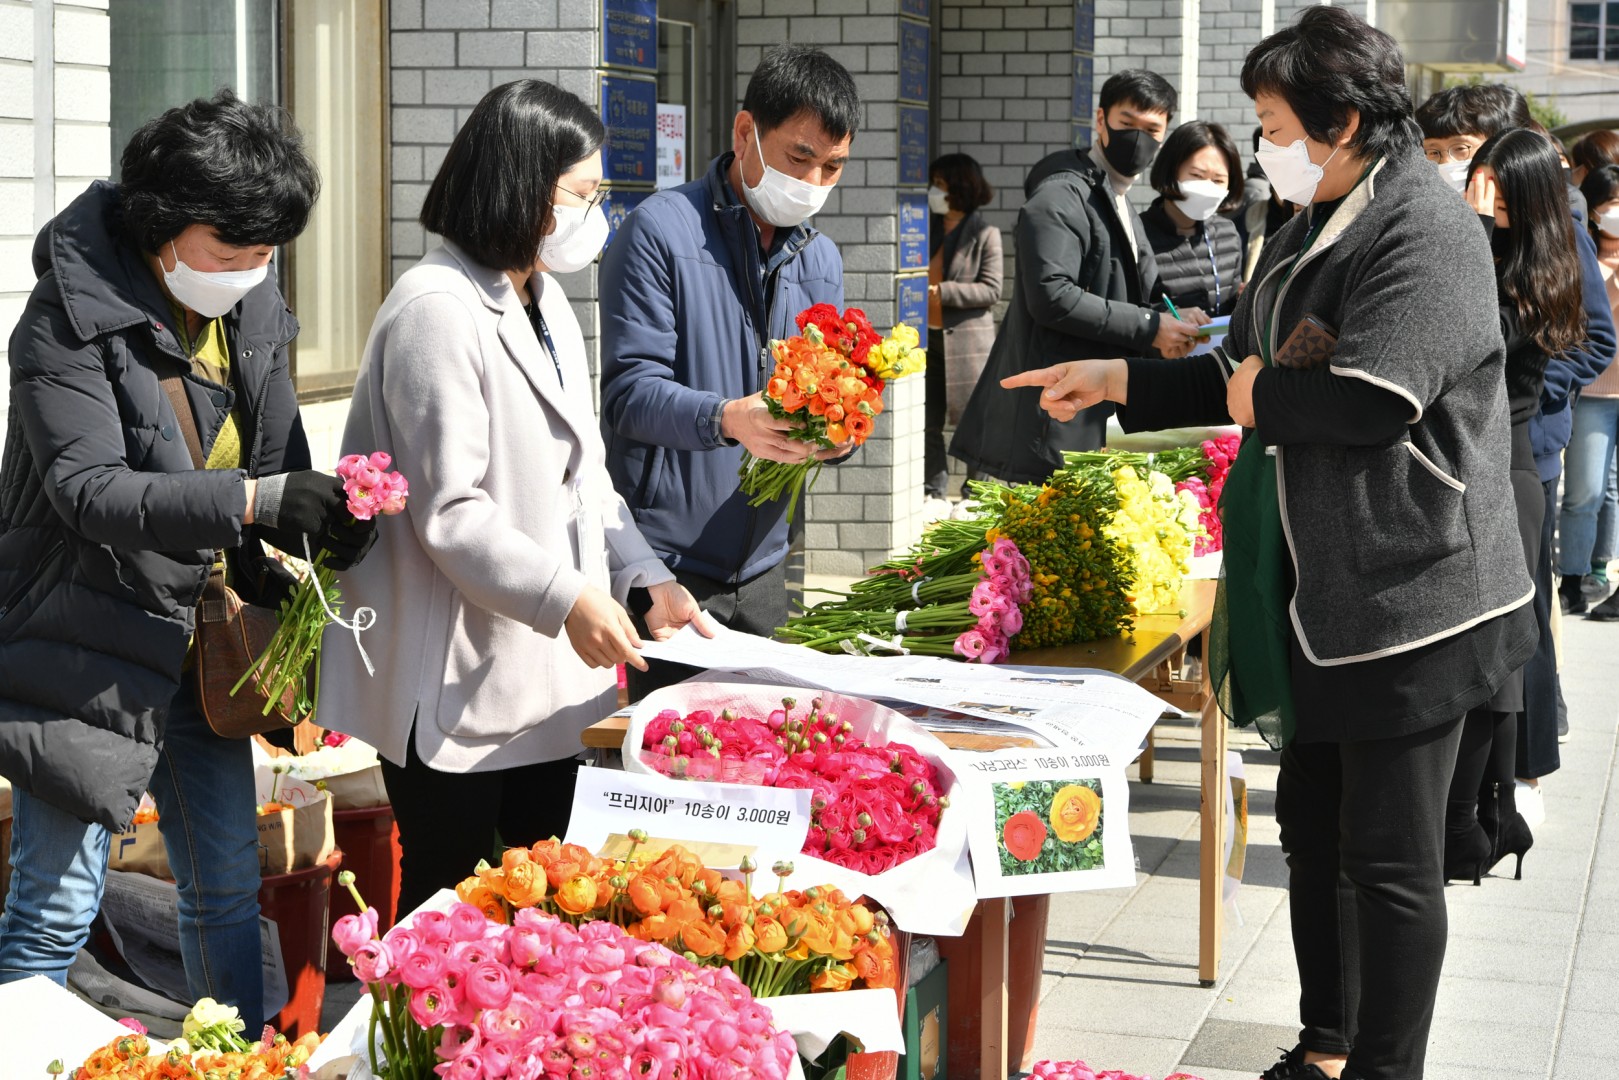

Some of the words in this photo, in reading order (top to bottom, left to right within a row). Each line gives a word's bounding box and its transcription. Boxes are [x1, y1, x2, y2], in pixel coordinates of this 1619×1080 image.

[1035, 756, 1069, 769] 10송이
[602, 791, 675, 815] “프리지아”
[684, 802, 730, 821] 10송이
[736, 807, 791, 826] 3,000원
